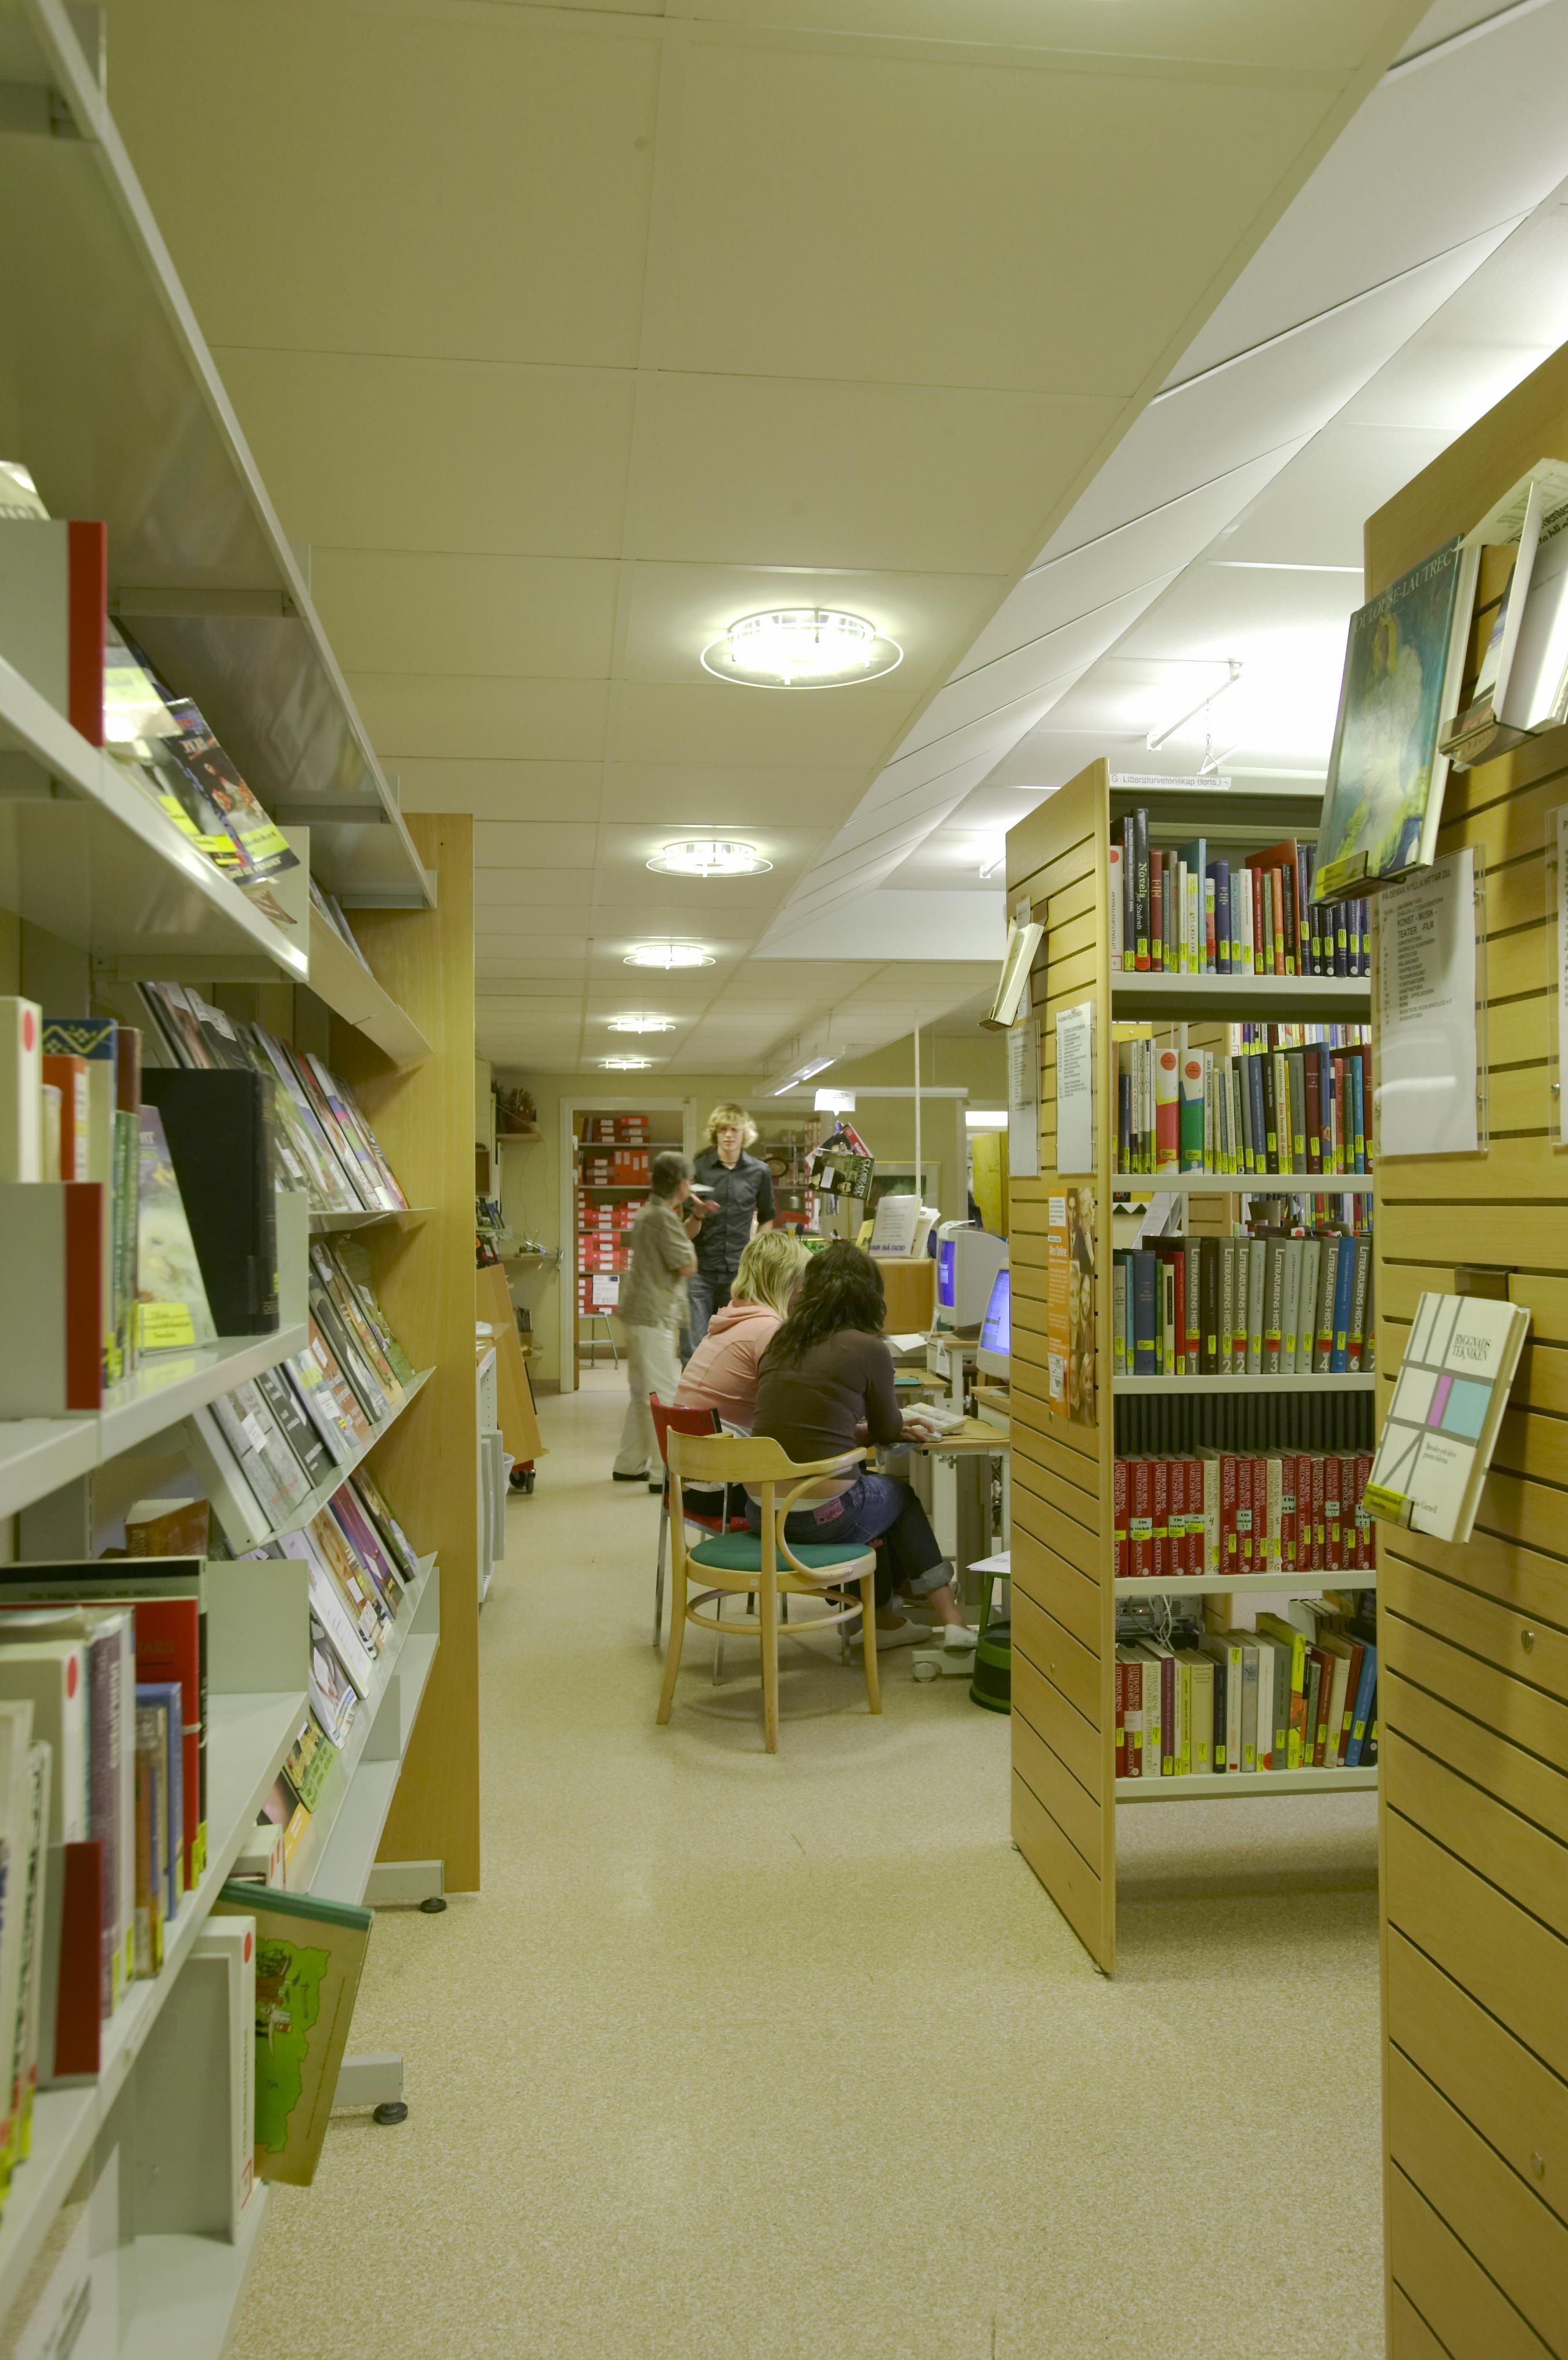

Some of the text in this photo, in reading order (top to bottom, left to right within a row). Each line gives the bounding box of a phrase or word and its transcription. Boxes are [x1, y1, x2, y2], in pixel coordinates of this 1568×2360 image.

[1355, 548, 1453, 632] OULOUSE-LAUTREC
[1123, 775, 1195, 786] Litteraturvetenskap
[1139, 863, 1147, 898] Novels
[1397, 909, 1433, 927] KONST MUSIK
[1398, 926, 1417, 939] TEATER
[1191, 1249, 1200, 1308] LITTERATURENS
[1224, 1249, 1234, 1308] LITTERATURENS
[1239, 1249, 1249, 1308] LITTERATURENS
[1274, 1249, 1285, 1308] LITTERATURENS
[1324, 1248, 1339, 1331] LITTERATURENS HISTO
[1354, 1246, 1369, 1334] LITTERATURENS HISTOR
[1455, 1334, 1491, 1349] BYGGNADS
[1452, 1345, 1488, 1361] TEKNIKEN
[1191, 1360, 1196, 1373] 1
[1222, 1359, 1231, 1373] 2
[1237, 1359, 1245, 1373] 2
[1270, 1359, 1278, 1372] 3
[1319, 1357, 1328, 1372] 4
[1350, 1357, 1359, 1369] 6
[1209, 1517, 1214, 1526] 4
